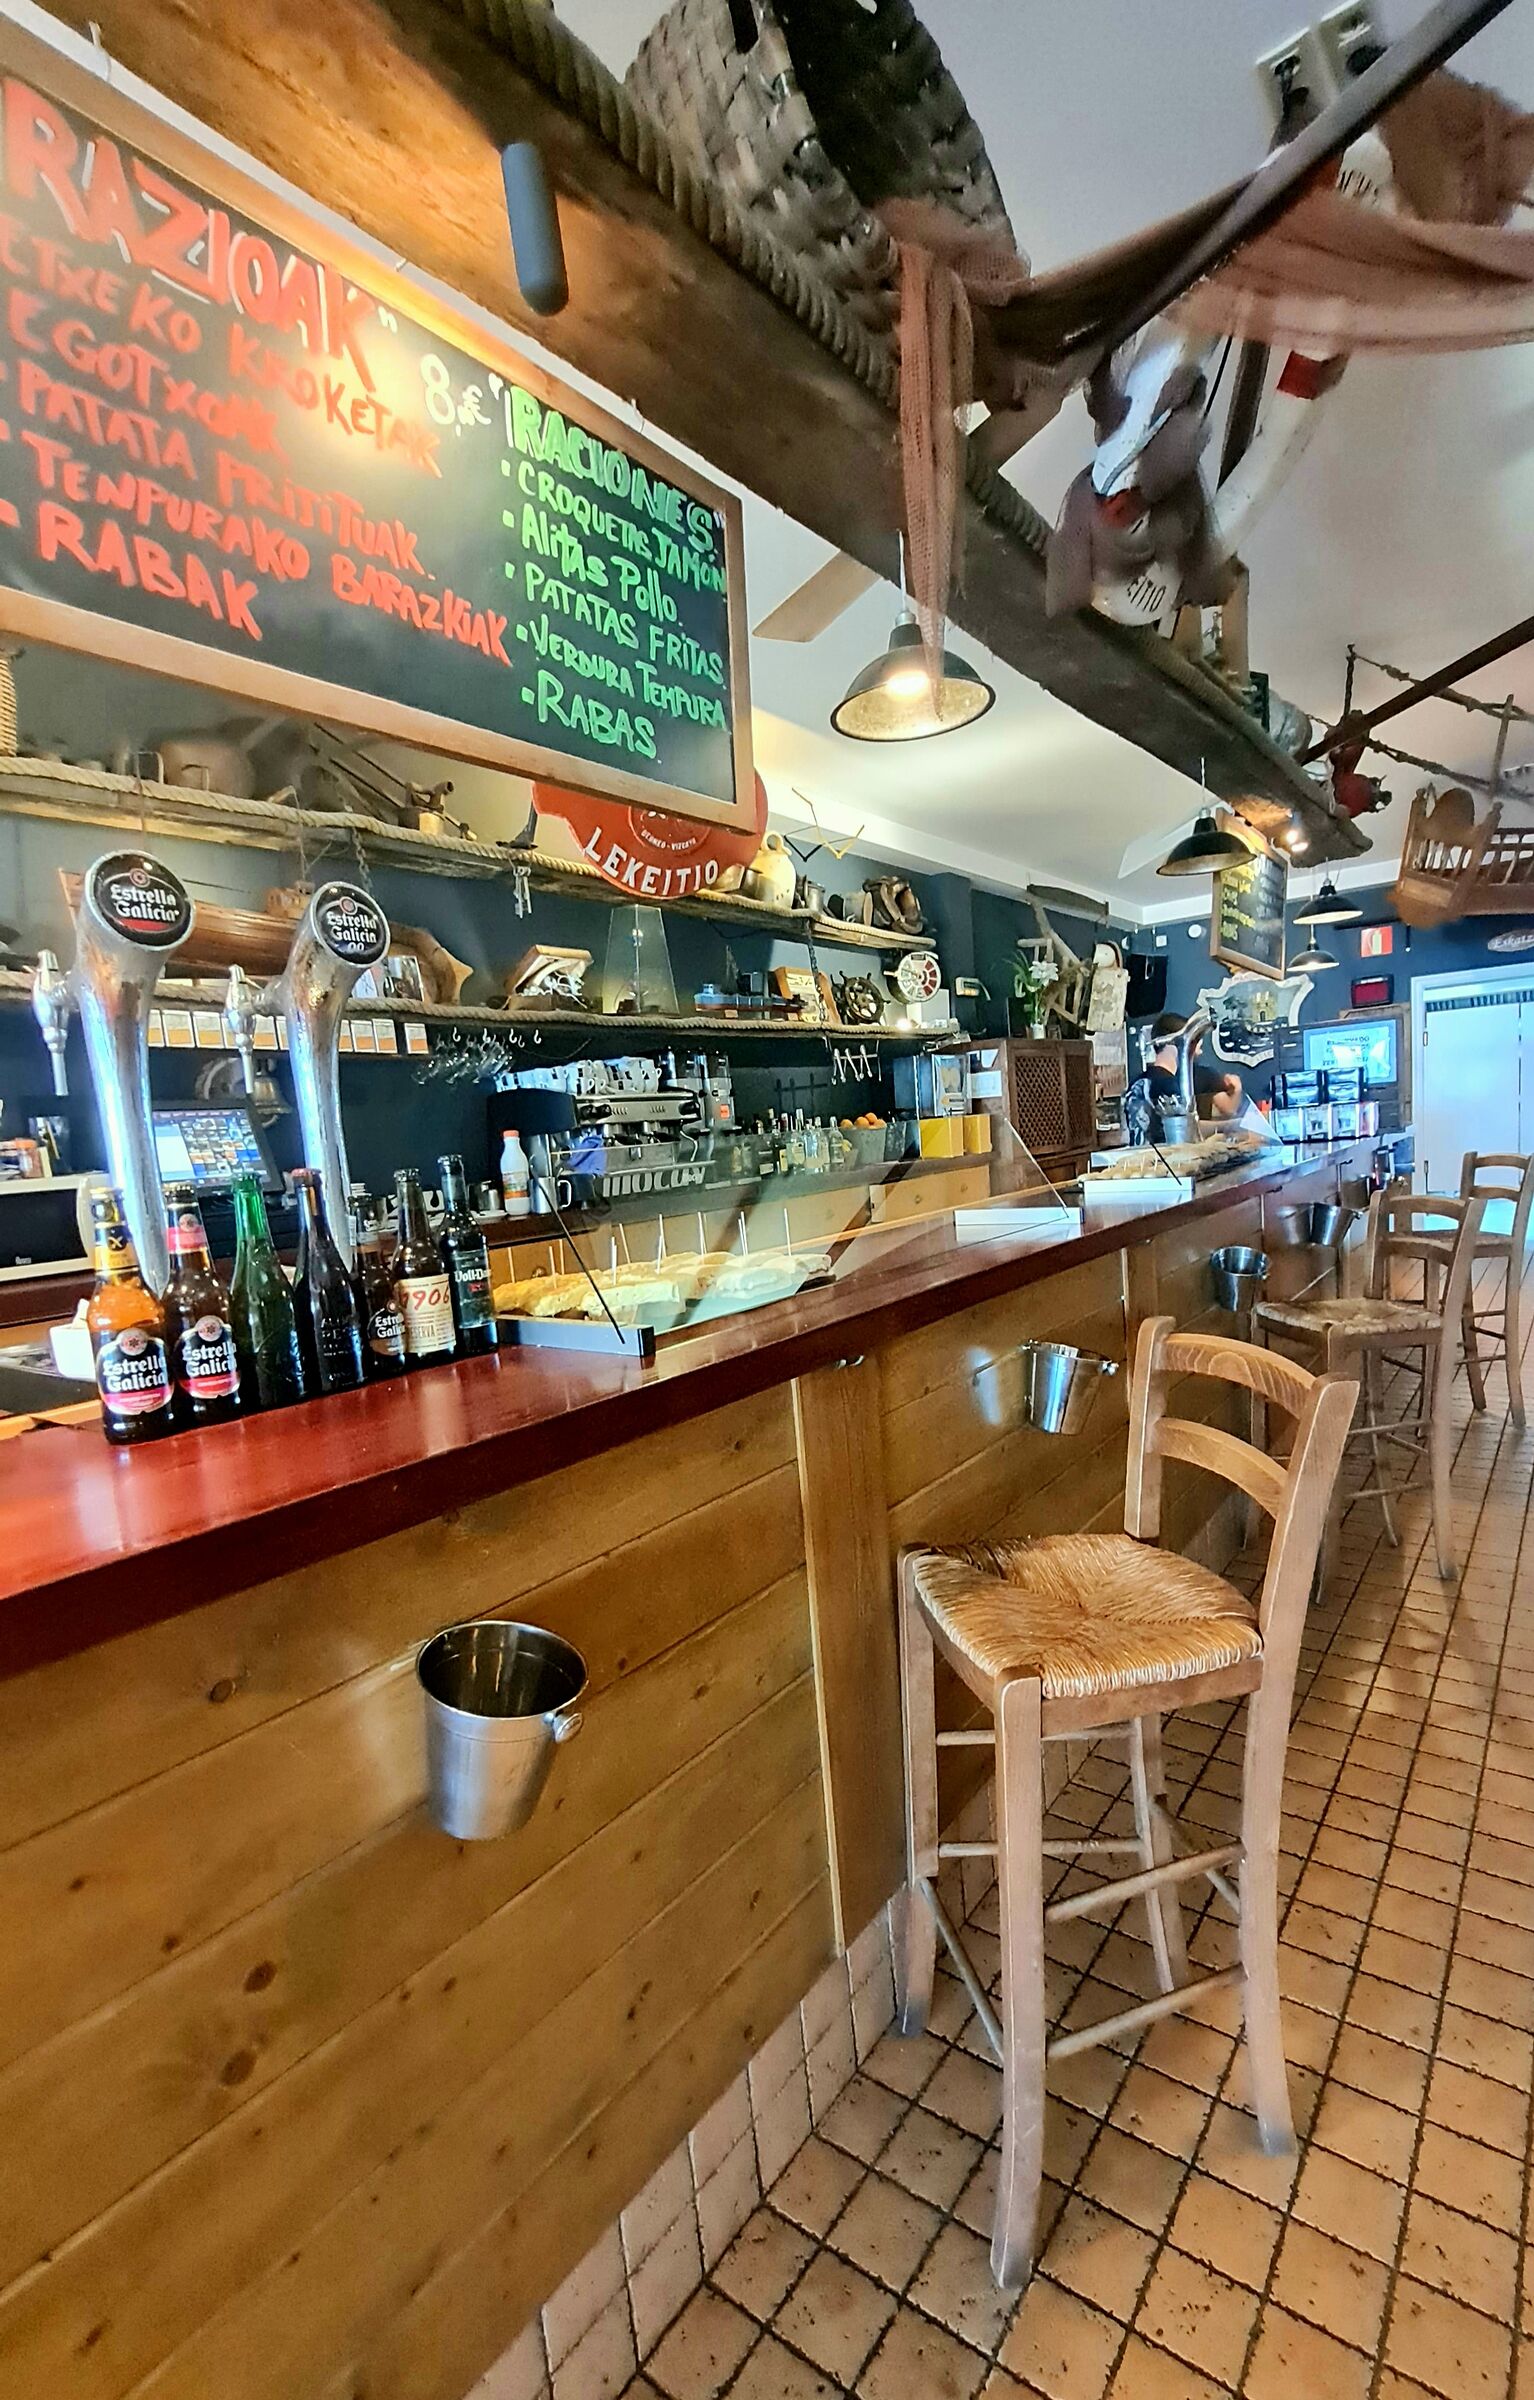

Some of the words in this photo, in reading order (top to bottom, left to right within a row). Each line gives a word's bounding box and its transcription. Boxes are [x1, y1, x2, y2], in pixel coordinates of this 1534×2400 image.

[18, 358, 198, 481] PATATA
[20, 429, 311, 583] TENPURAKO
[36, 500, 263, 642] RABAK
[524, 561, 639, 650] PATATAS
[531, 613, 635, 698] VERDURA
[635, 659, 727, 731] TEMPURA
[584, 826, 719, 896] LEKEITIO
[110, 883, 177, 906] Estrella
[112, 900, 177, 922] Galicia
[326, 910, 378, 930] Estrella
[331, 925, 378, 944] Galicia
[401, 1284, 450, 1310] 1906
[182, 1342, 237, 1361] Estrella
[102, 1354, 167, 1377] Estrella
[186, 1358, 237, 1377] Galicia
[106, 1370, 167, 1393] Galicia
